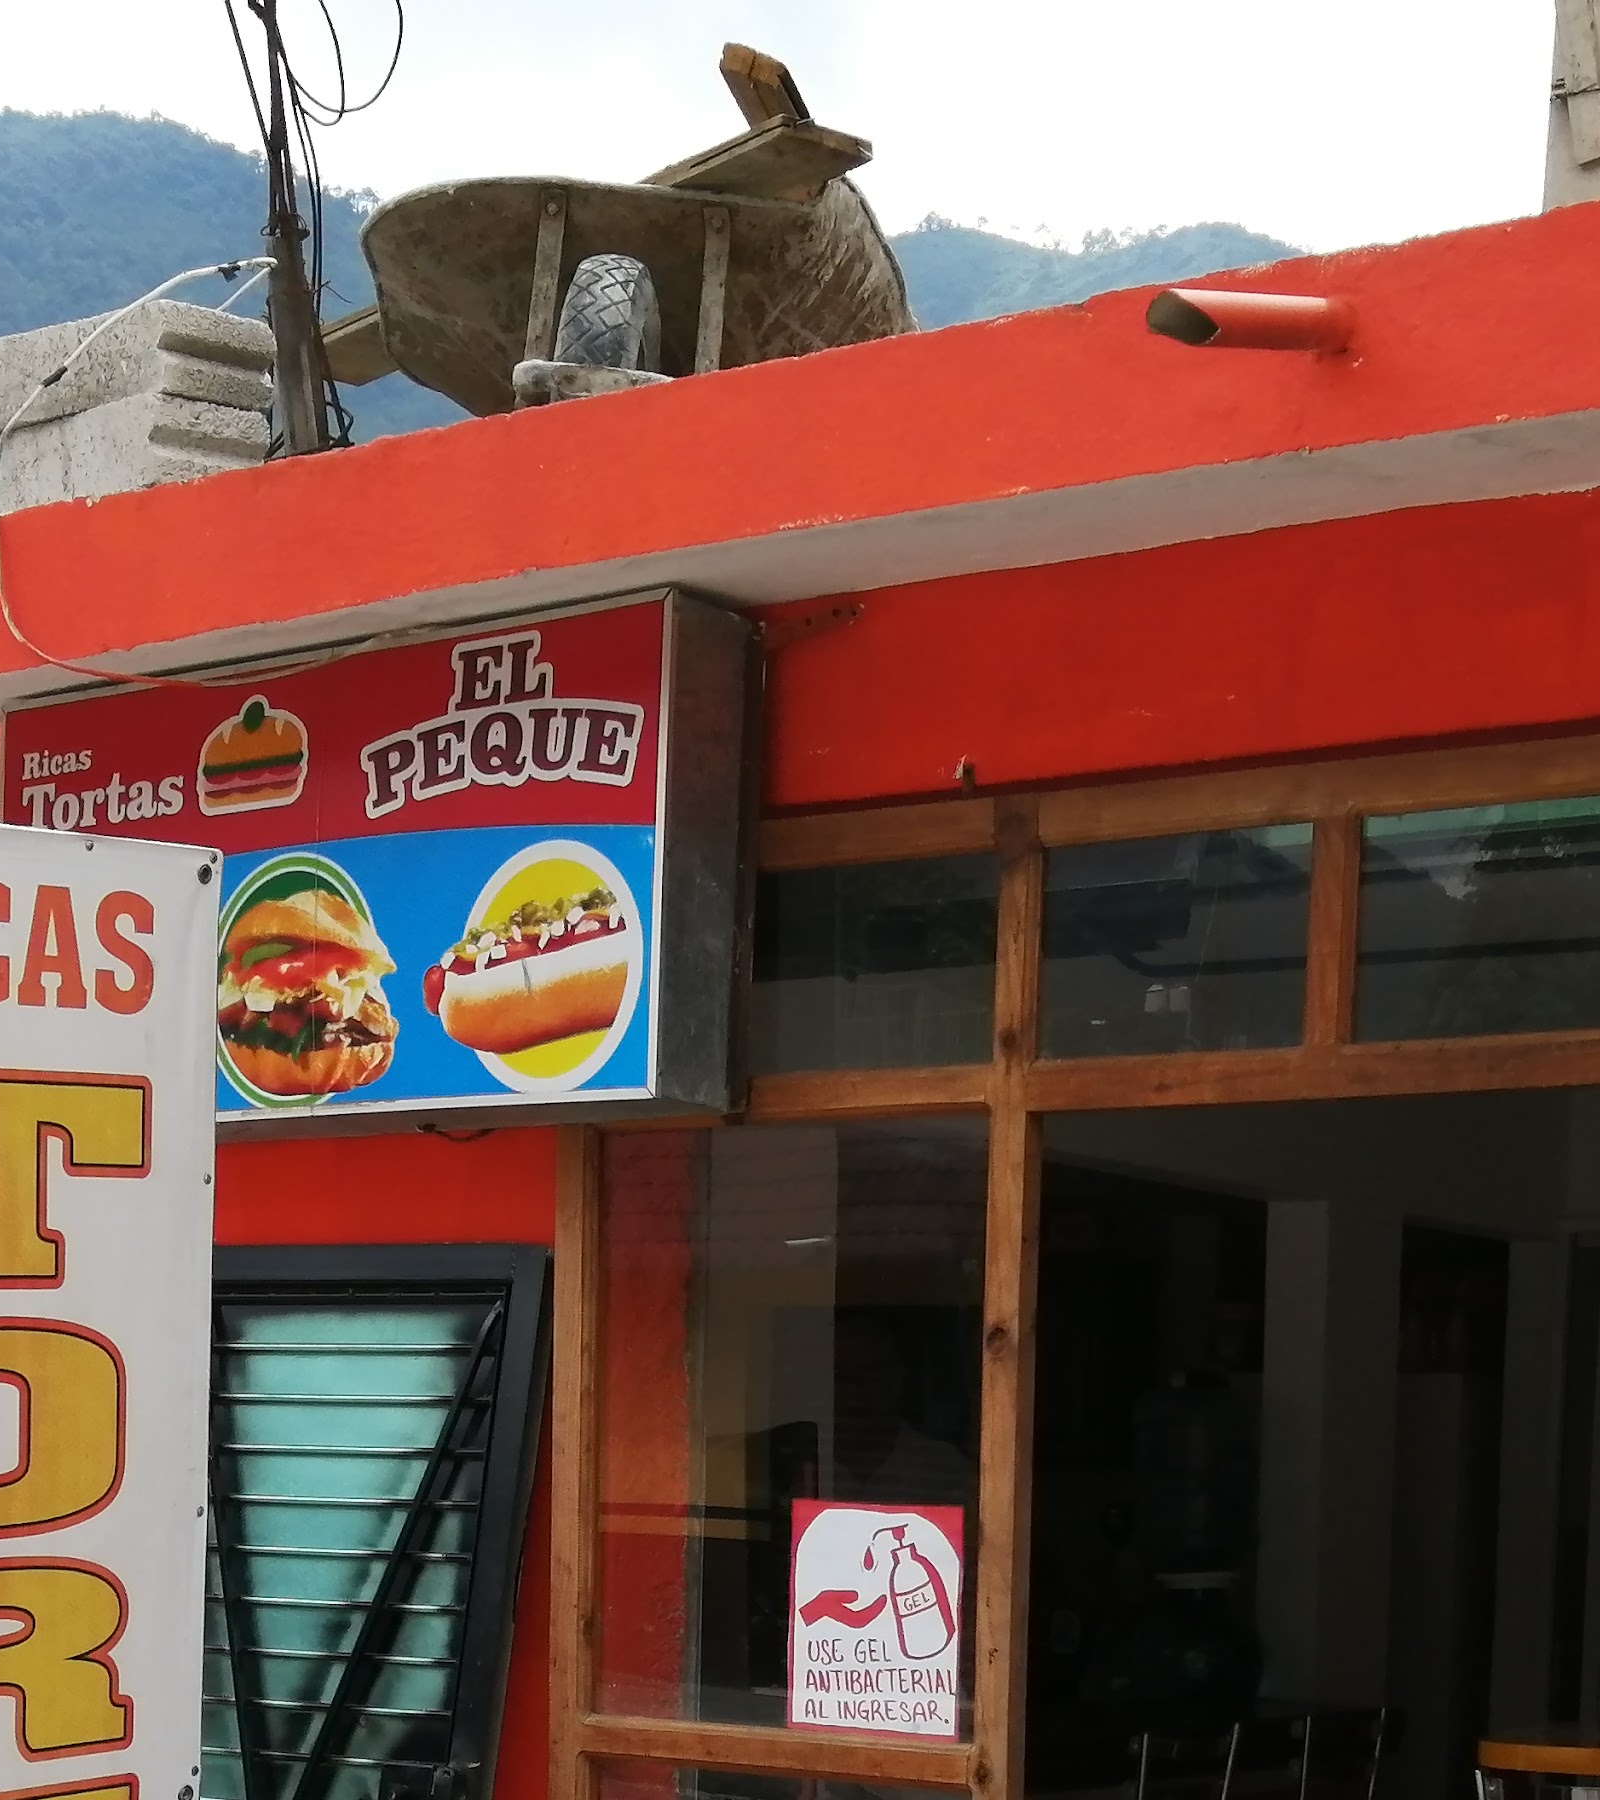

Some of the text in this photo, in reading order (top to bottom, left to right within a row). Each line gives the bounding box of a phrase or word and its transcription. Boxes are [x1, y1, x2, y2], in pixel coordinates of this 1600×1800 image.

[454, 637, 549, 712] EL
[21, 749, 94, 781] Ricas
[365, 705, 638, 811] PEQUE
[21, 772, 185, 831] Tortas
[902, 1591, 931, 1613] GEL
[806, 1637, 893, 1666] USE GEL
[805, 1667, 957, 1697] ANTIBACTERIAL
[804, 1698, 950, 1725] AL INGRESAR.
